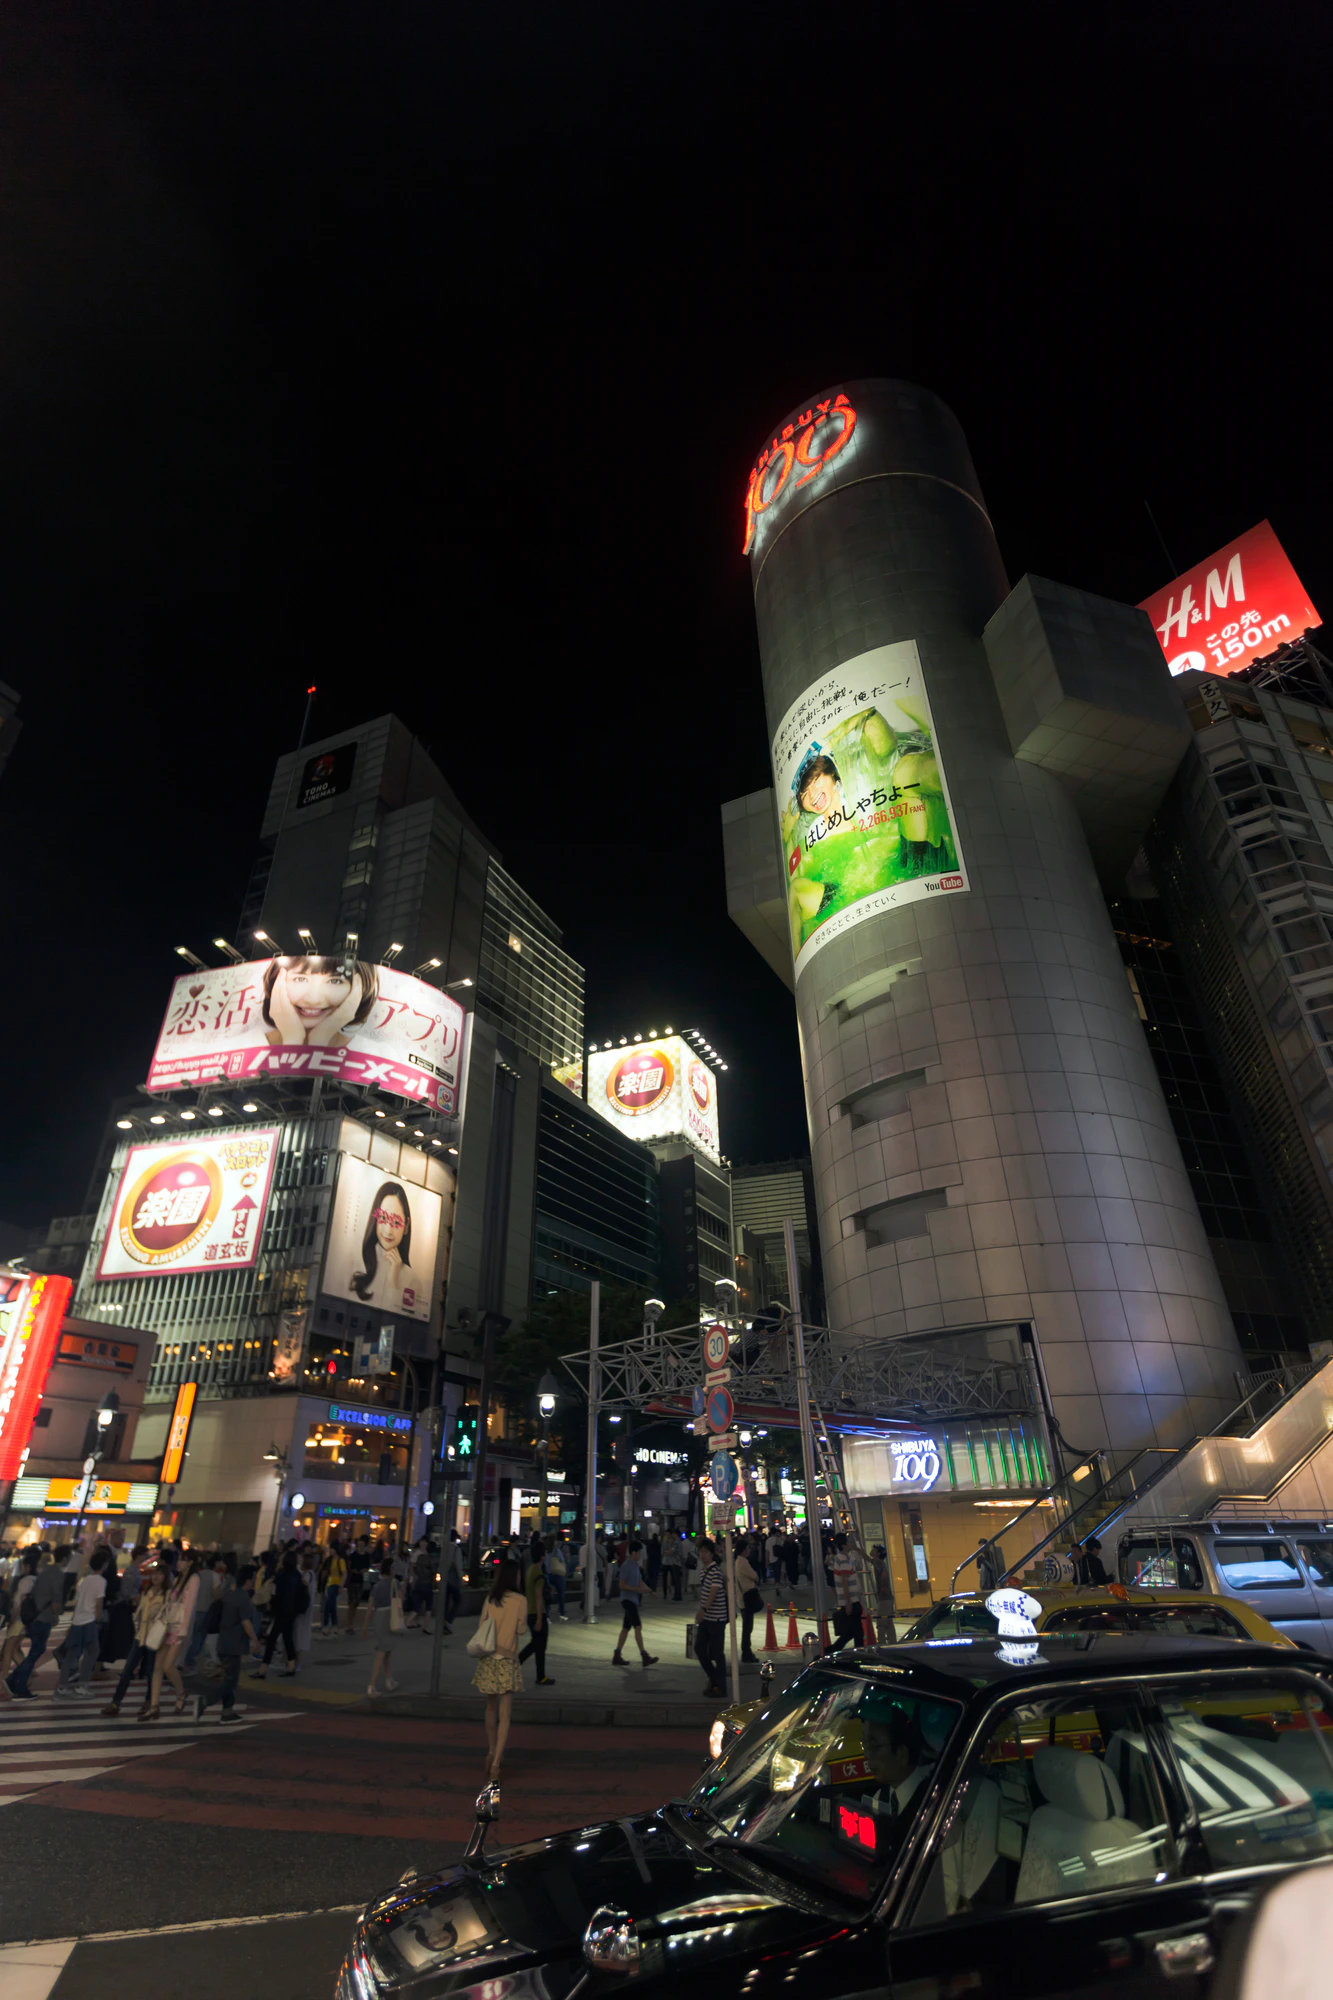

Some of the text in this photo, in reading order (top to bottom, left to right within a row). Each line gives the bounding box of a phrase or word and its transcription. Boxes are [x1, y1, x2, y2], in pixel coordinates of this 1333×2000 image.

[749, 393, 850, 485] SHIBUYA
[742, 406, 857, 555] 109
[1156, 553, 1245, 648] H&M
[1206, 609, 1262, 649] この先
[1211, 613, 1291, 668] 150m
[303, 786, 336, 804] CINEMAS
[305, 782, 329, 797] TOHO
[804, 782, 921, 852] はじめしゃちょー
[909, 803, 926, 814] FANS
[924, 876, 963, 892] YouTube
[166, 984, 459, 1059] 恋活 アプリ
[247, 1047, 430, 1098] ハッピーメール
[617, 1066, 664, 1098] 楽園
[224, 1151, 267, 1171] スロット
[132, 1185, 211, 1230] 楽園
[203, 1240, 249, 1261] 道玄坂
[709, 1336, 724, 1358] 30
[329, 1404, 412, 1431] EXCELSIOR CAFF
[890, 1438, 937, 1455] SHIBUYA
[715, 1464, 725, 1495] P
[892, 1452, 941, 1491] 109
